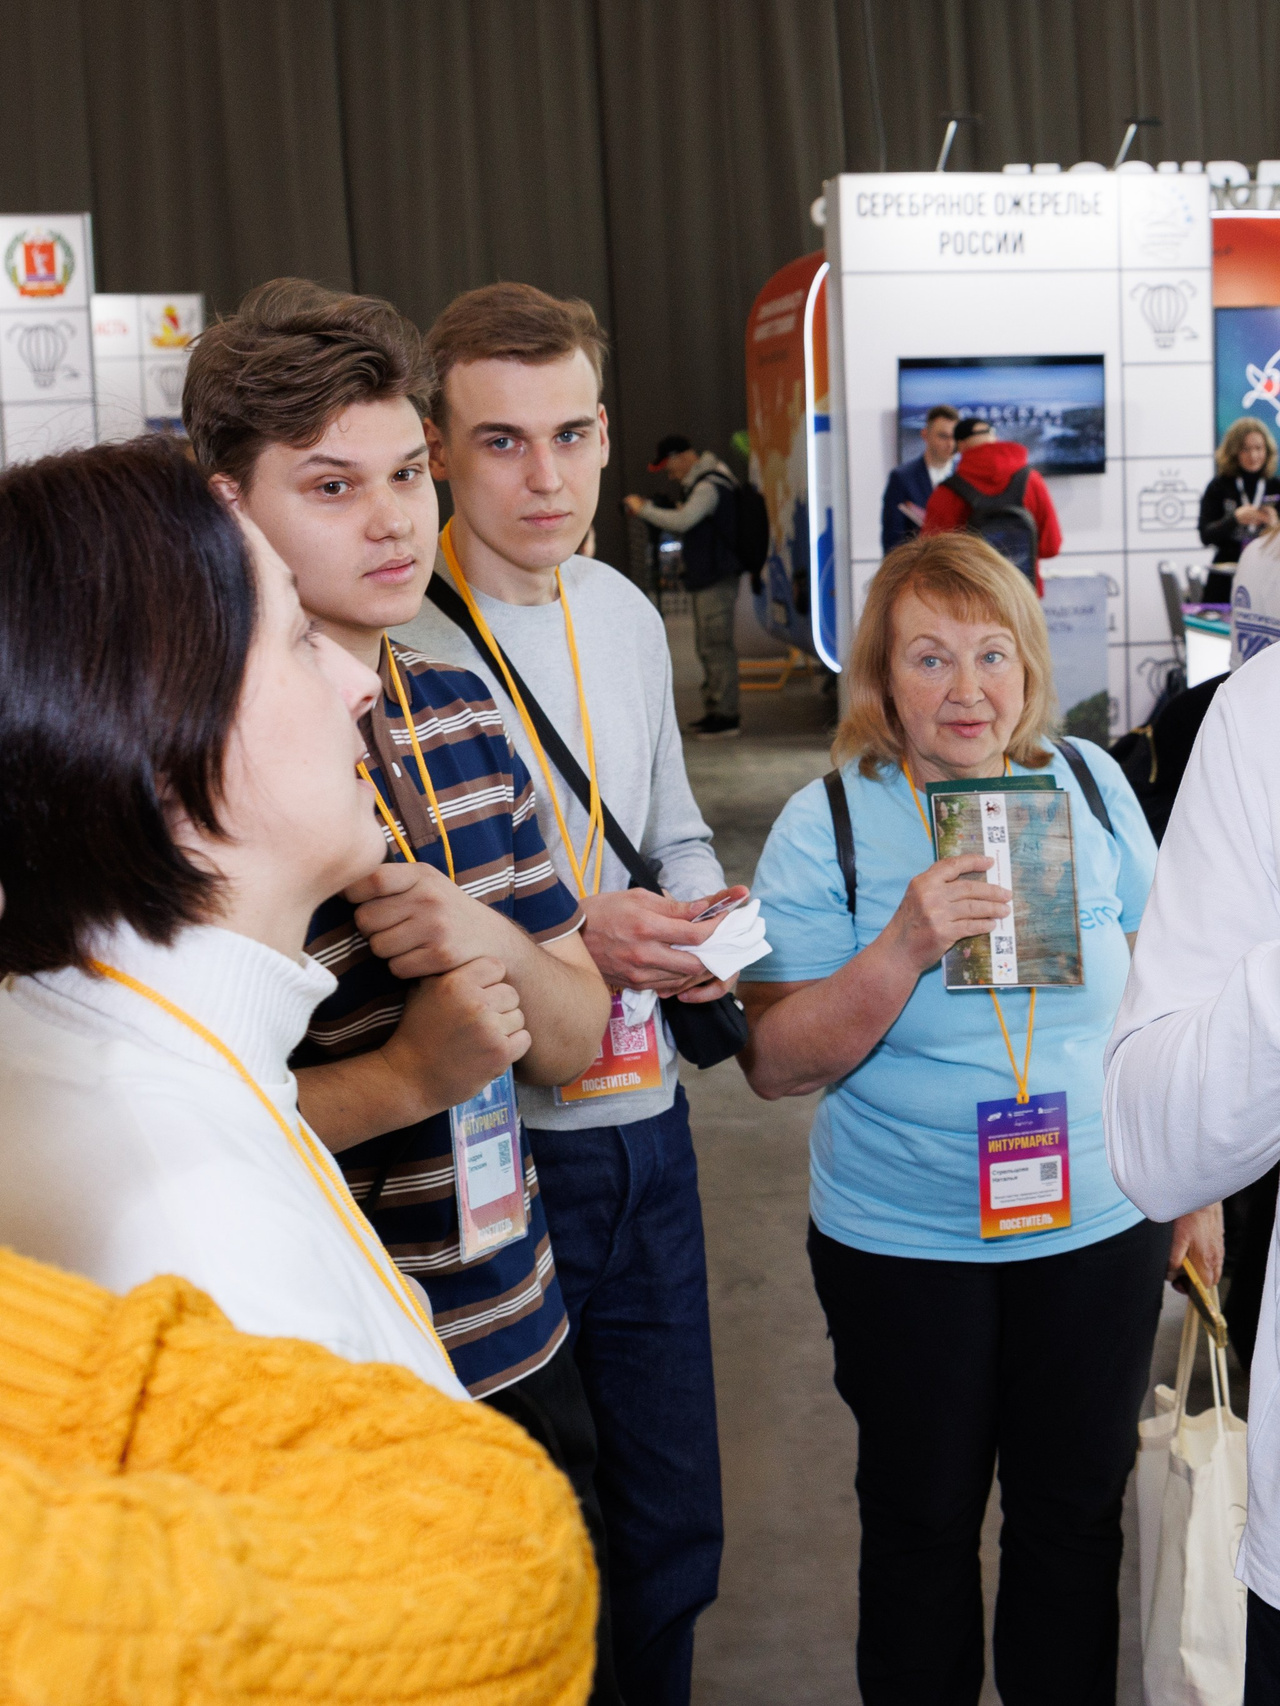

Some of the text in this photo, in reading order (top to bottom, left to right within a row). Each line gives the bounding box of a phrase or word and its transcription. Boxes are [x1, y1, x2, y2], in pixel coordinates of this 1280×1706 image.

[857, 191, 1104, 217] СЕРЕБРЯНОЕ ОЖЕРЕЛЬЕ
[939, 231, 1026, 255] РОССИИ
[582, 1072, 642, 1093] ПОСЕТИТЕЛЬ
[988, 1132, 1060, 1154] ИНТУРМАРКЕТ
[999, 1213, 1054, 1231] ПОСЕТИТЕЛЬ
